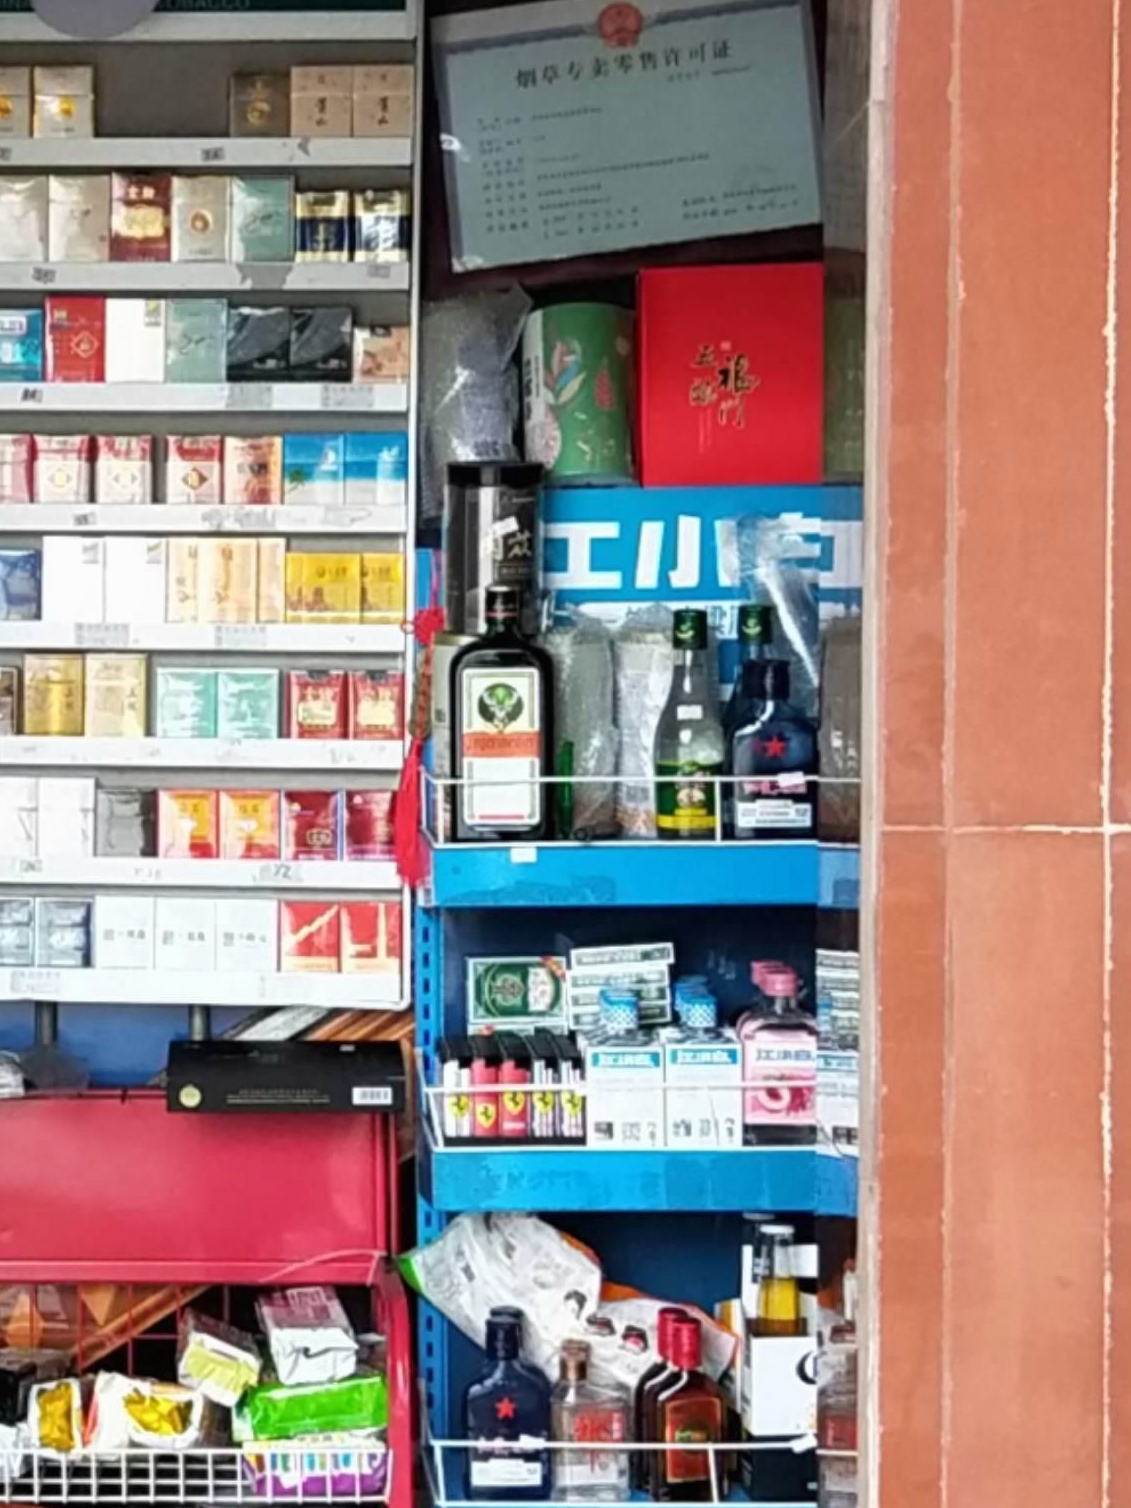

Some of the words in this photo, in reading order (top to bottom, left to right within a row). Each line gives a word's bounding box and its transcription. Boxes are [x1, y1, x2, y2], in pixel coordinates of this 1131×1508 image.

[516, 38, 733, 90] 烟草专卖零售许可证
